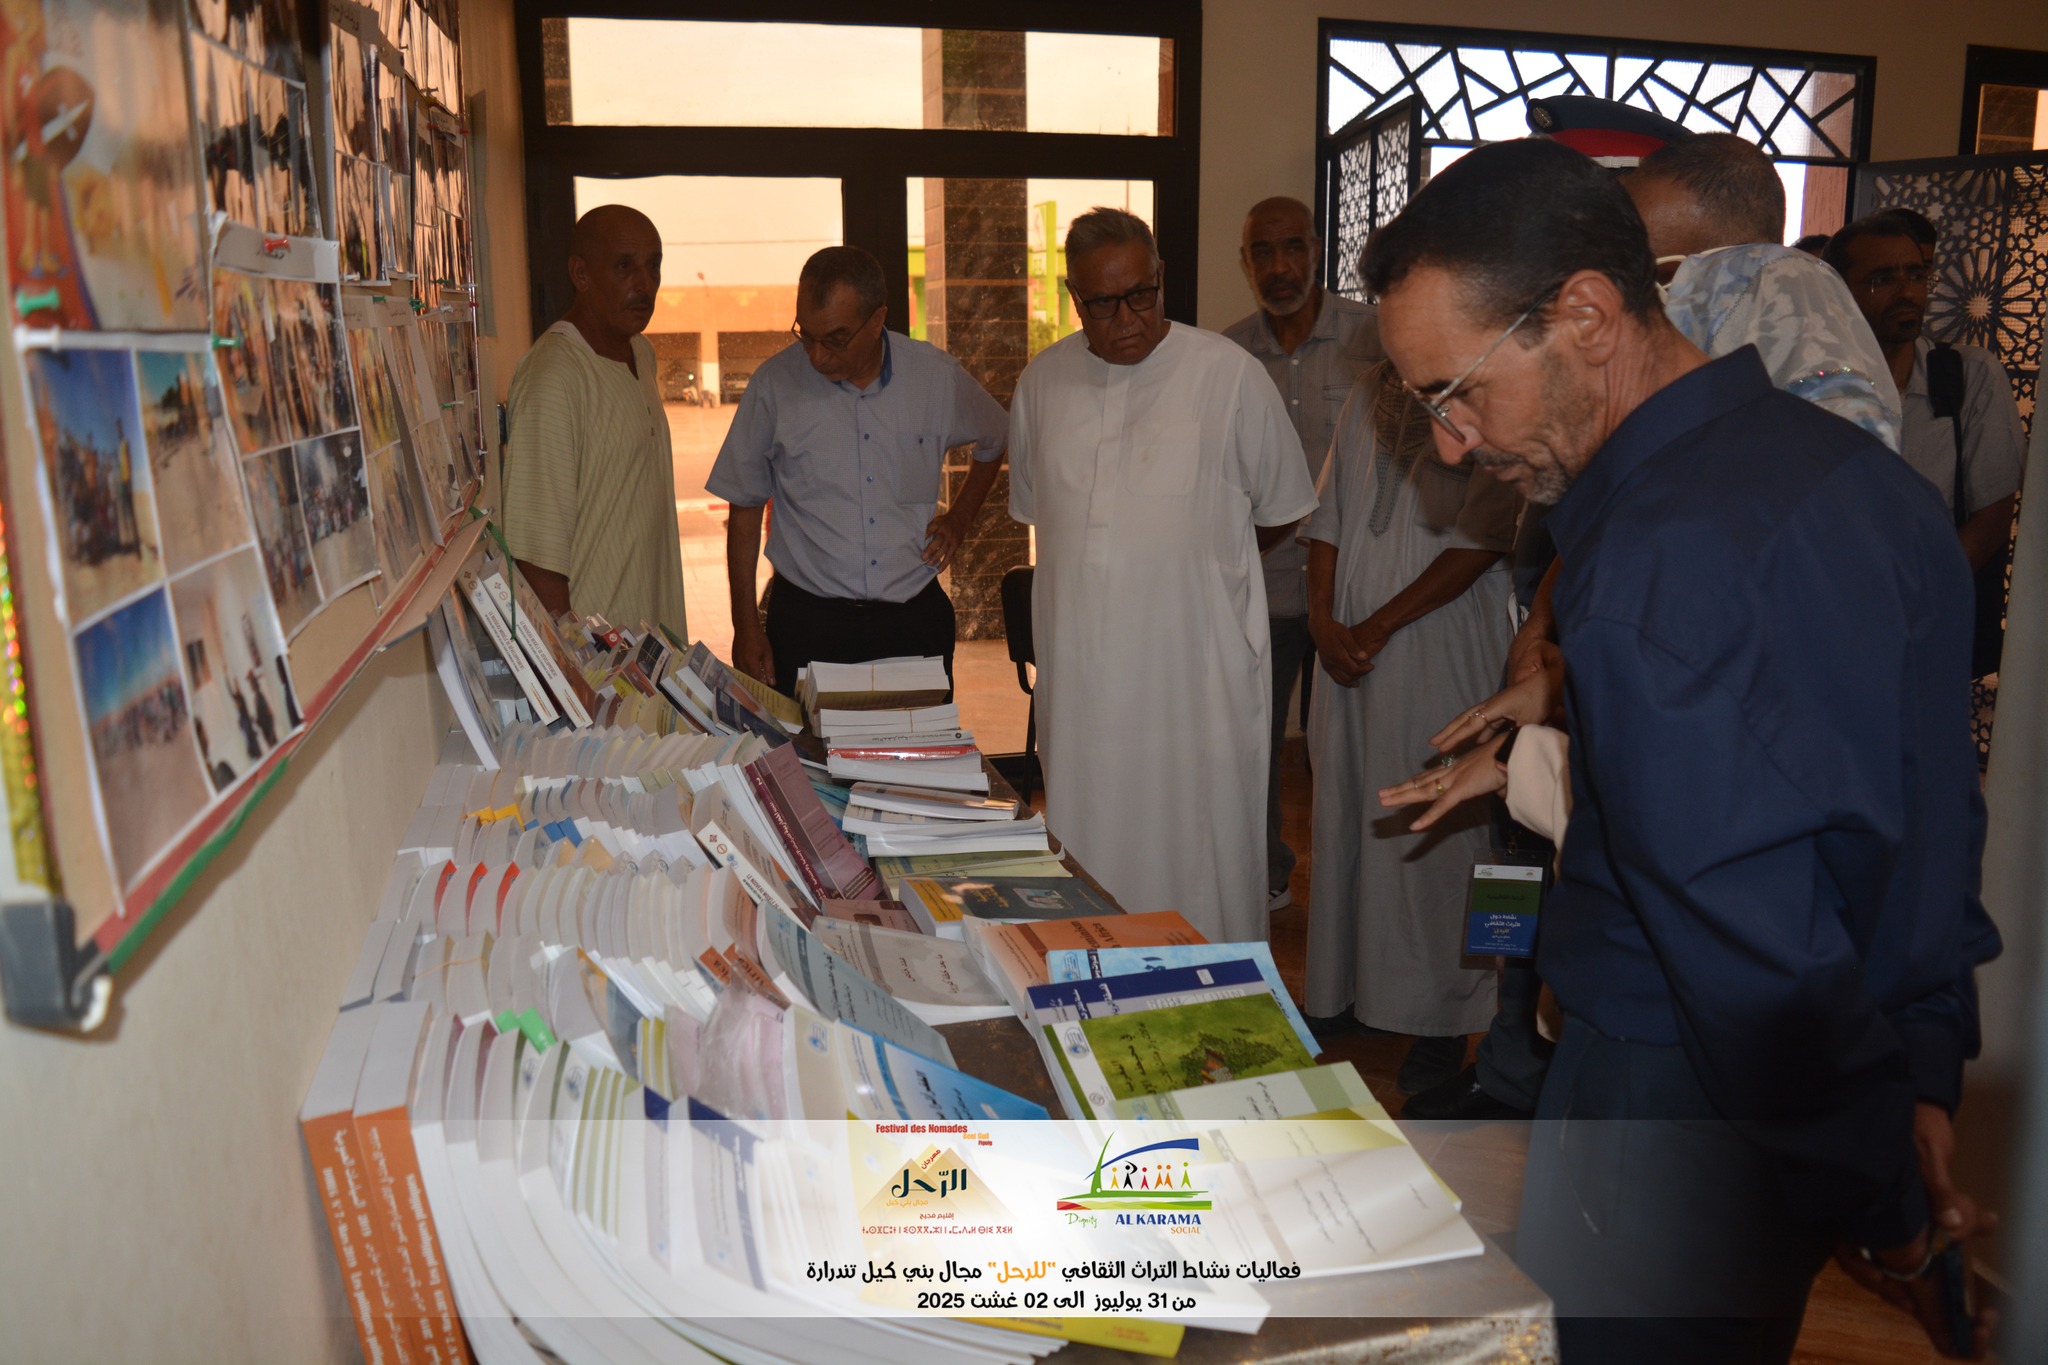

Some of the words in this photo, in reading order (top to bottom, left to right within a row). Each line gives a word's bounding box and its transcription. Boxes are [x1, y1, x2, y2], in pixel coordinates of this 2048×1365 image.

[749, 877, 765, 894] NOUVEAU
[1070, 920, 1101, 949] eminism
[1092, 922, 1115, 942] Africa
[330, 1128, 356, 1168] العمومية
[341, 1166, 368, 1209] السياسات
[404, 1173, 427, 1220] publiques
[336, 1222, 351, 1245] Mars
[355, 1213, 373, 1238] 2019
[341, 1244, 358, 1269] 2019
[413, 1221, 440, 1267] politiques
[349, 1270, 365, 1291] Les
[426, 1267, 442, 1285] Les
[432, 1288, 448, 1311] 2019
[352, 1290, 378, 1335] politiques
[438, 1311, 453, 1332] Mars
[365, 1335, 386, 1365] publiq
